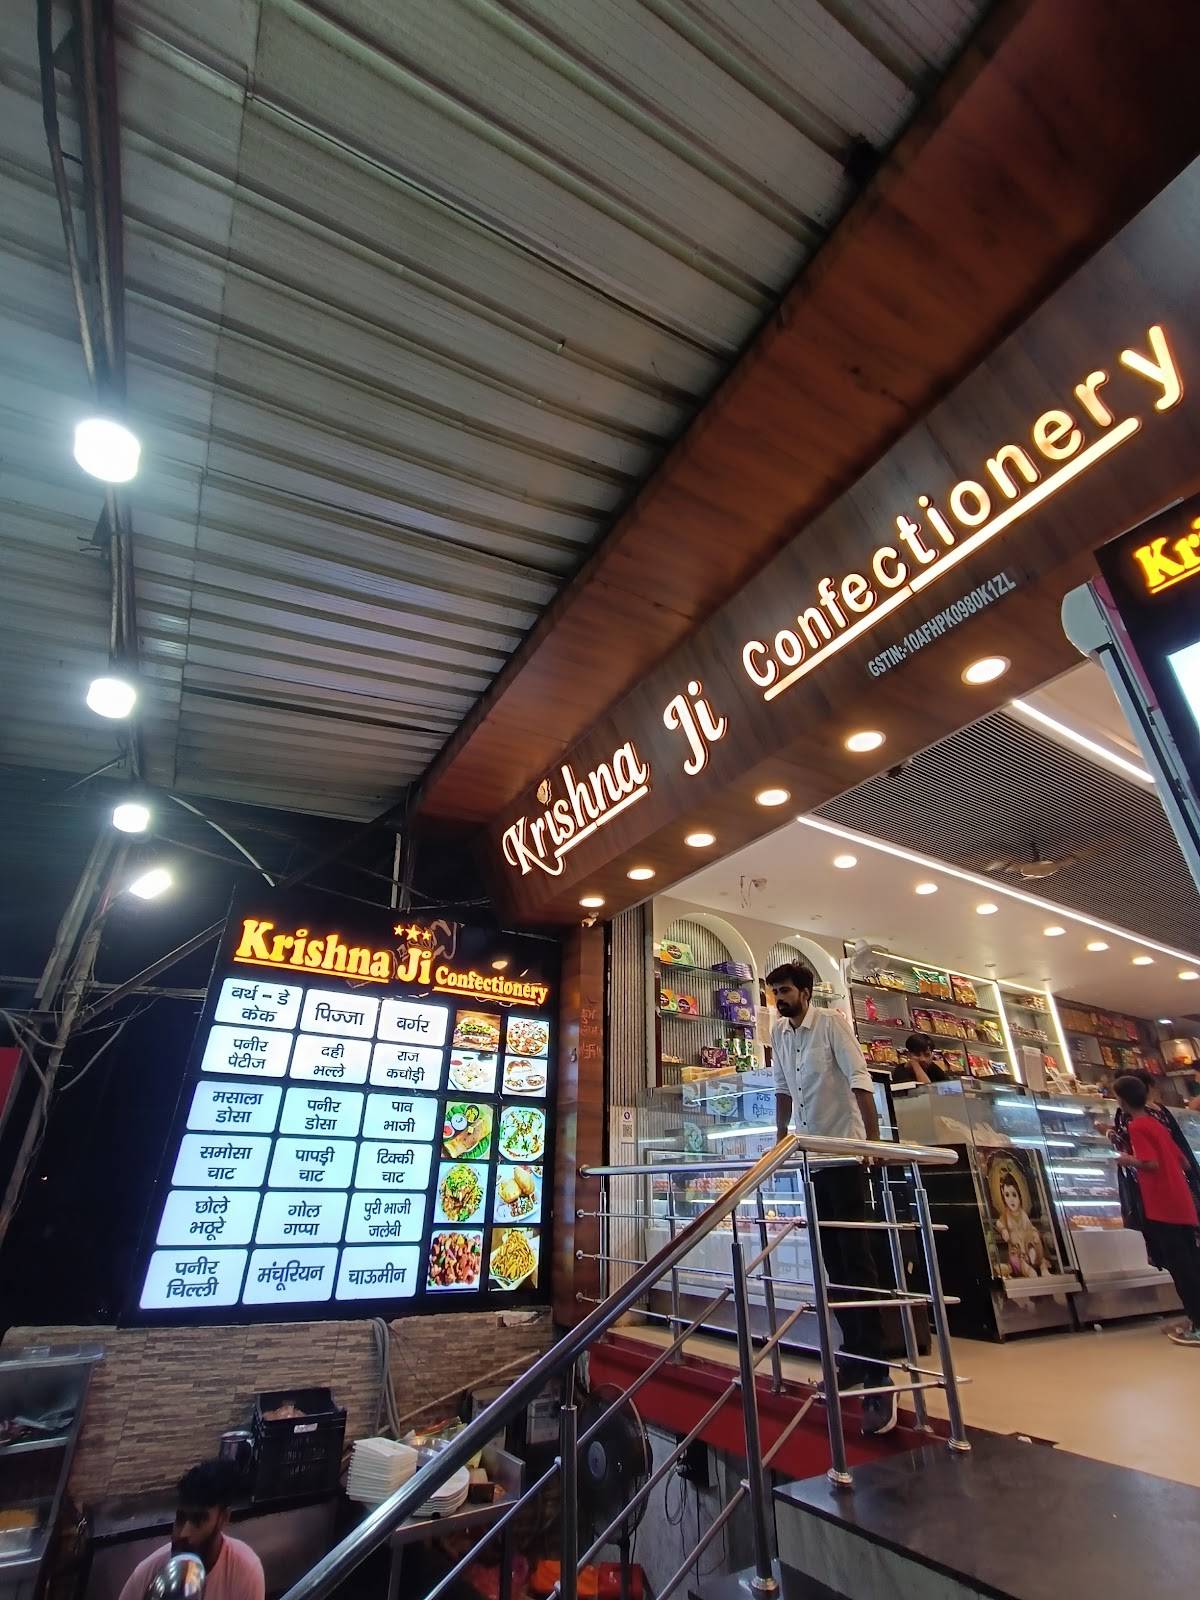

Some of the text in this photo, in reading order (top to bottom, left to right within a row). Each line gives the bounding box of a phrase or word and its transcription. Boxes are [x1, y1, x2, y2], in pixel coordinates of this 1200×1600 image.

[502, 325, 1183, 876] Krishna Ji Confectionery
[236, 919, 548, 1004] Krishna Ji Confectionery
[232, 984, 259, 1001] बर्थ
[277, 988, 291, 1005] डे
[242, 1004, 278, 1022] केक
[315, 1003, 365, 1026] पिज्जा
[396, 1014, 430, 1033] बर्गर
[233, 1036, 269, 1052] पनीर
[322, 1044, 345, 1059] दही
[228, 1052, 266, 1069] पैटीज
[397, 1051, 420, 1063] राज
[313, 1063, 345, 1078] भल्ले
[212, 1089, 263, 1106] मसाला
[307, 1097, 341, 1113] पनीर
[216, 1107, 252, 1123] डोसा
[391, 1101, 414, 1113] पाव
[304, 1114, 337, 1131] डोसा
[383, 1117, 416, 1133] भाजी
[200, 1143, 251, 1160] समोसा
[295, 1147, 335, 1165] पापड़ी
[376, 1149, 415, 1166] टिक्की
[207, 1167, 234, 1180] चाट
[299, 1169, 325, 1182] चाट
[381, 1171, 405, 1183] चाट
[195, 1196, 229, 1214] छोले
[288, 1201, 322, 1218] गोल
[363, 1198, 412, 1221] पुरी भाजी
[189, 1217, 227, 1239] भठूरे
[283, 1223, 320, 1236] गप्पा
[175, 1257, 219, 1277] पनीर
[257, 1260, 325, 1291] मंचूरियन
[348, 1262, 407, 1285] चाऊमीन
[166, 1276, 220, 1299] चिल्ली
